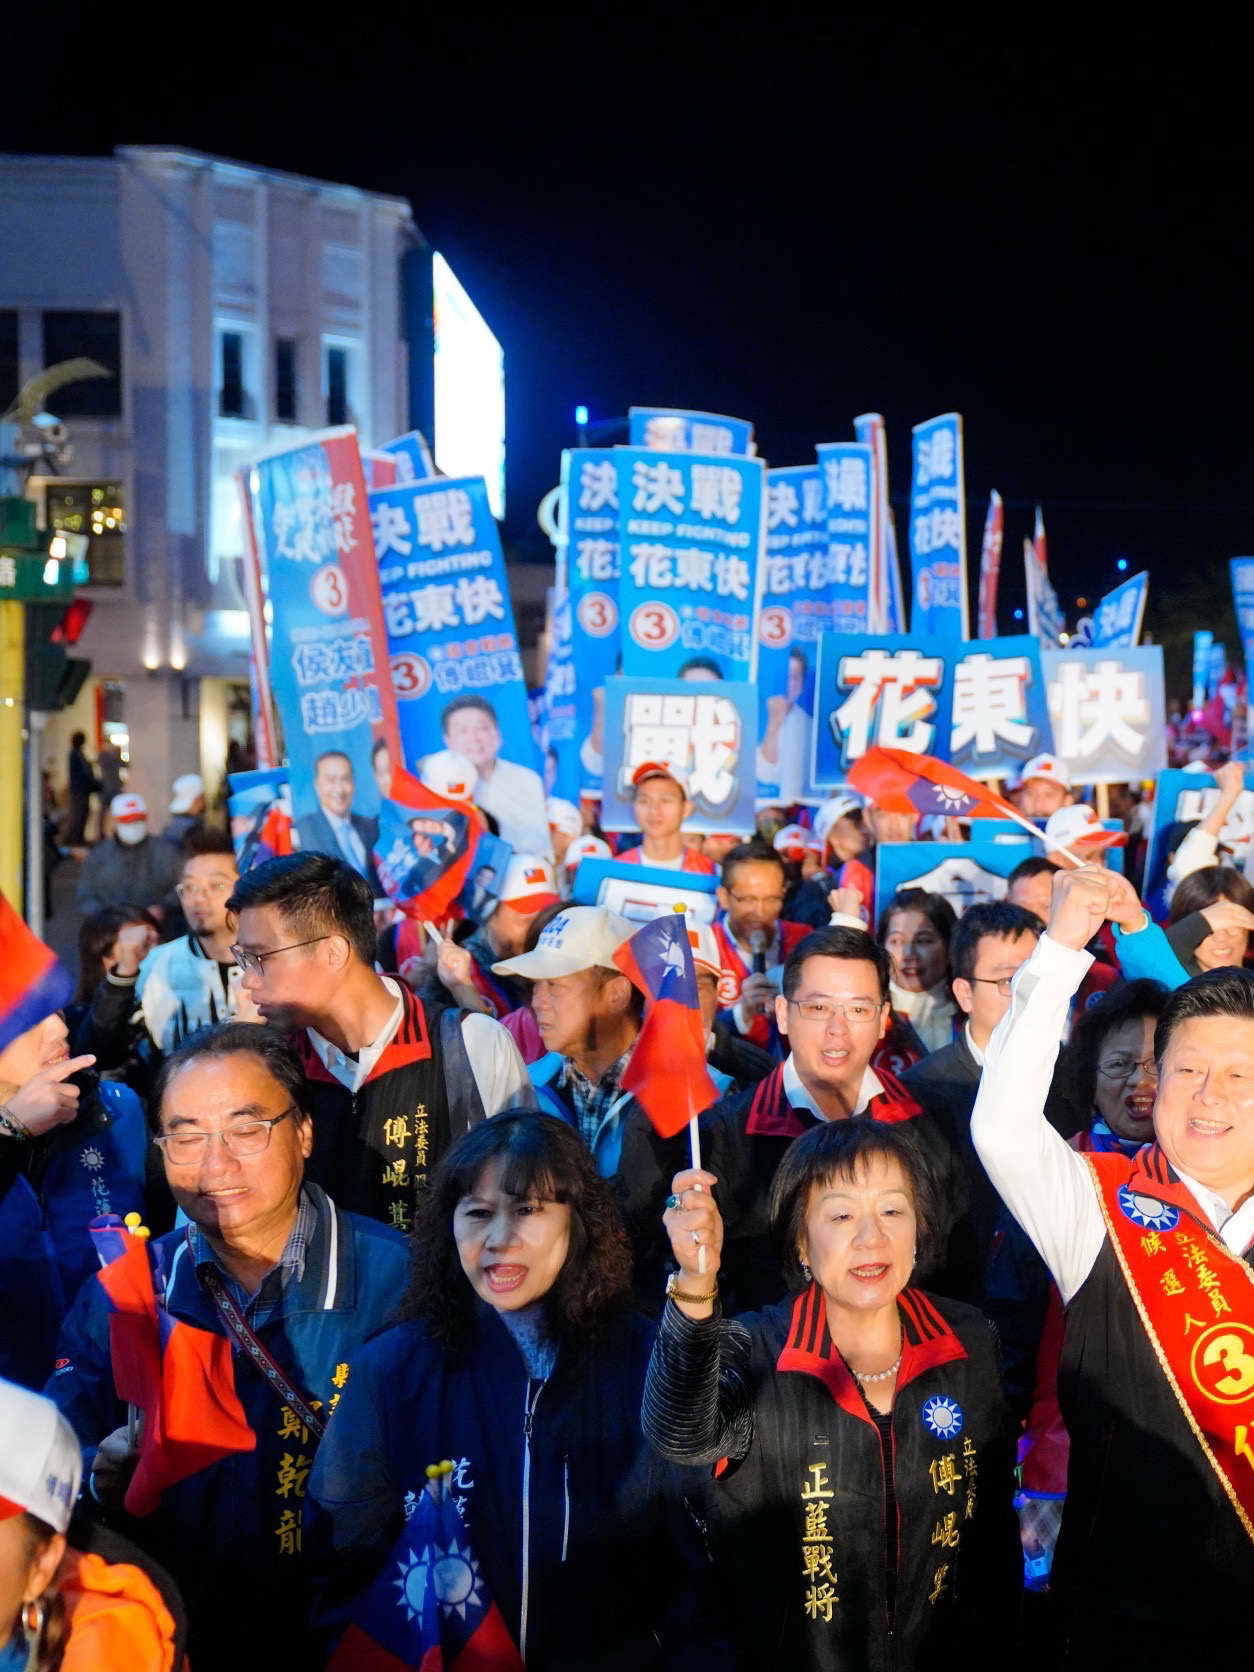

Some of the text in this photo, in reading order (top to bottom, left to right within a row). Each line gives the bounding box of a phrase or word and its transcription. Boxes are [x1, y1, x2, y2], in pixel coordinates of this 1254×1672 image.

[632, 461, 743, 525] 決戰
[629, 542, 750, 600] 花東快
[1050, 660, 1150, 760] 快
[1140, 1231, 1208, 1336] 候選人
[1175, 1231, 1233, 1320] 立法委員
[800, 1461, 840, 1623] 正藍戰將
